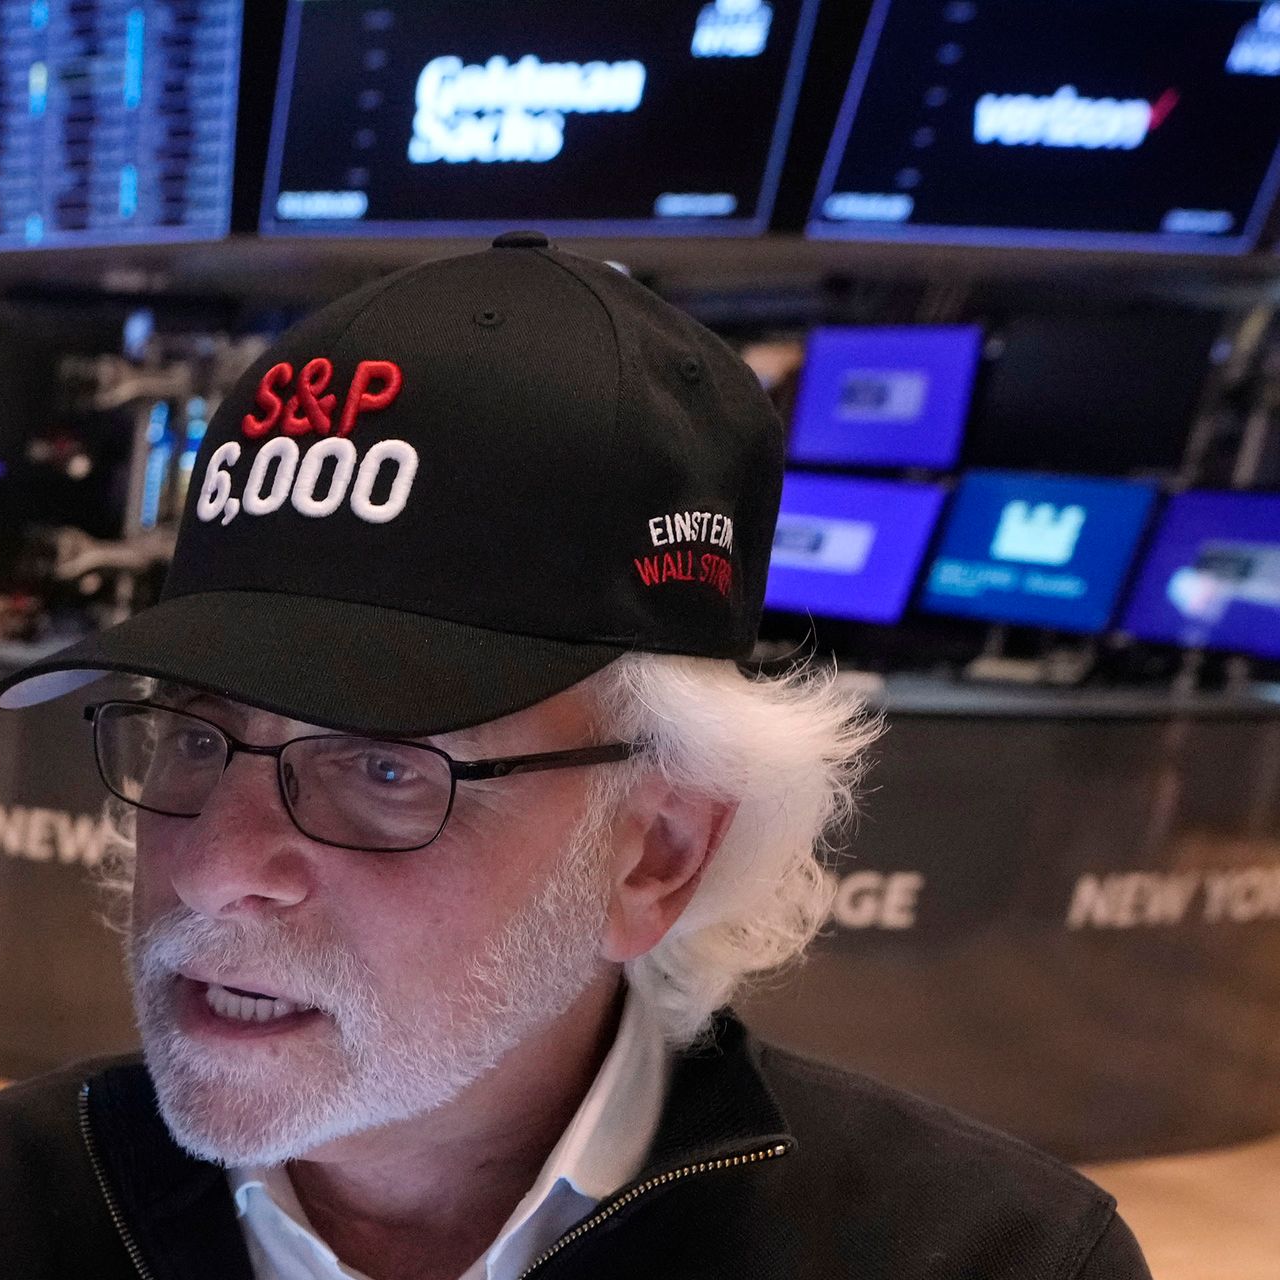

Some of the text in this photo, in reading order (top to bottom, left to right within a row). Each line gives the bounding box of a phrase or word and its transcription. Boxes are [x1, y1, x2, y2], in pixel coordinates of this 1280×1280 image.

[973, 84, 1152, 149] verizon
[242, 358, 403, 439] S&P
[197, 436, 420, 526] 6,000
[633, 550, 695, 586] WALL
[1066, 871, 1196, 930] NEW
